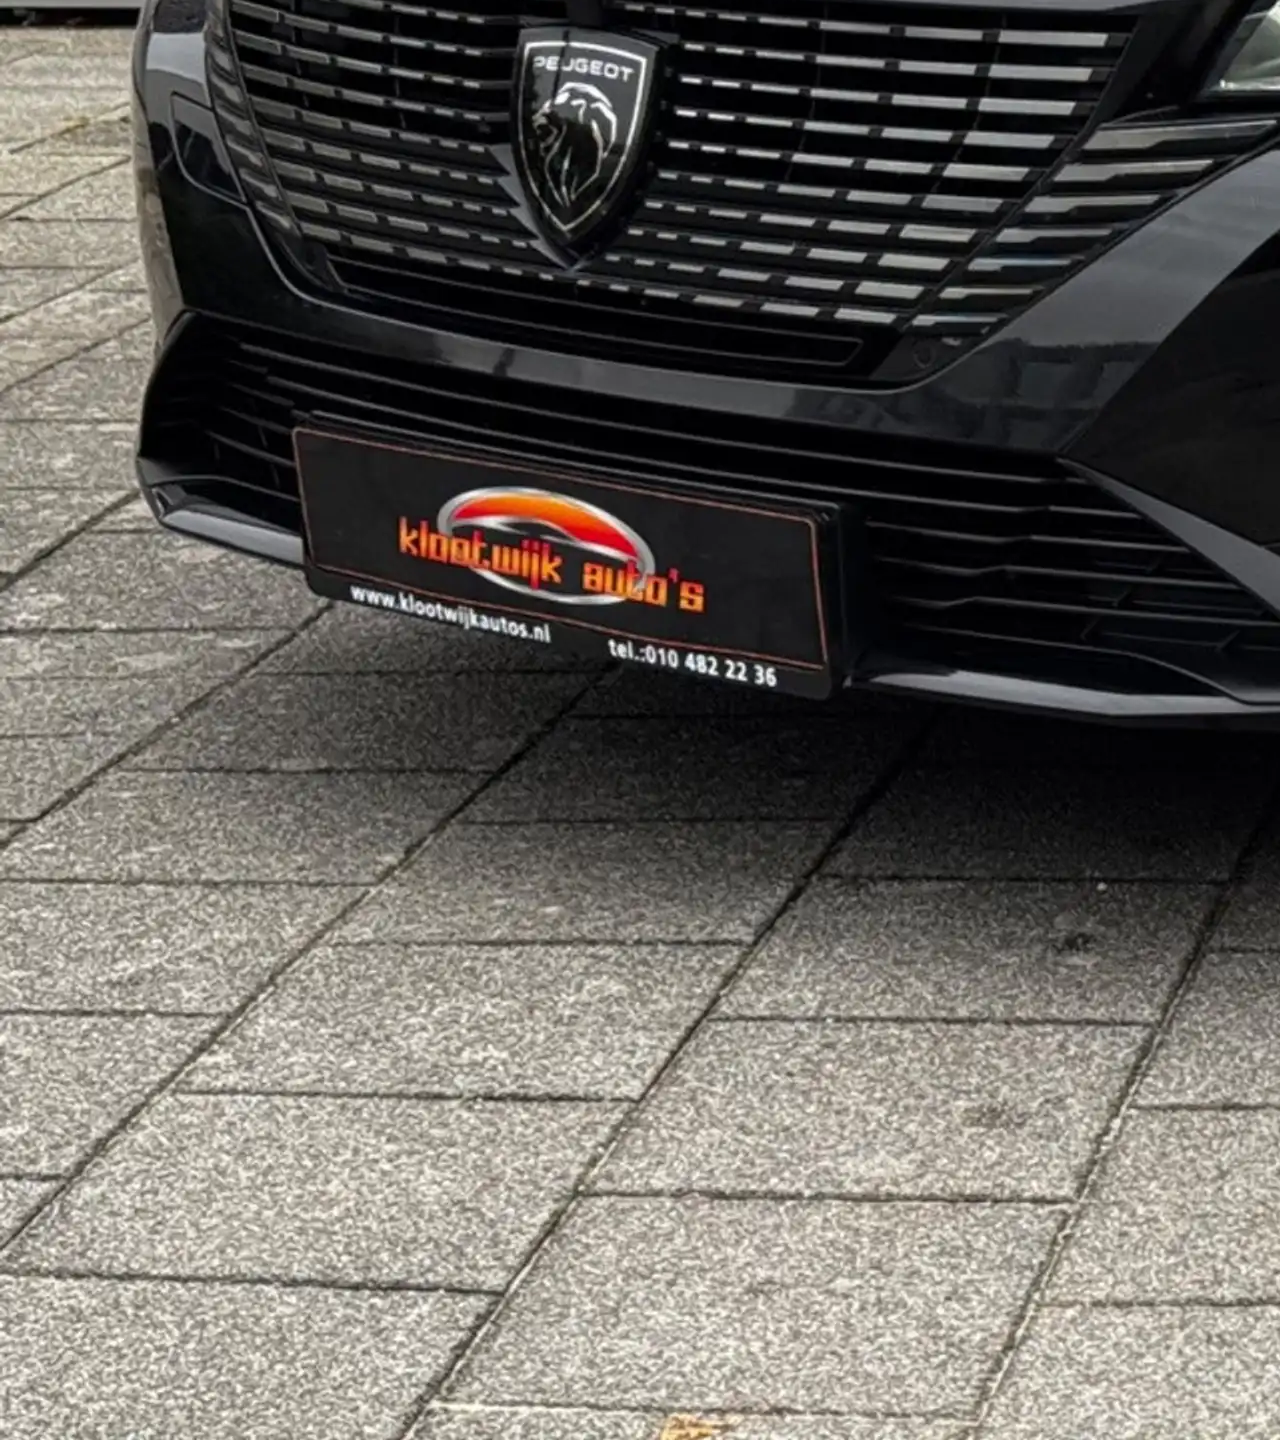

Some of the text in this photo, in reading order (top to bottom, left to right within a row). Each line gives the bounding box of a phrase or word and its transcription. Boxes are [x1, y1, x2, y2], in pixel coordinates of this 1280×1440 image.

[533, 55, 635, 82] PEUGEOT
[399, 516, 705, 612] klootwijk auto's
[350, 584, 551, 644] www.klootwijkautos.nl
[684, 653, 720, 676] 482
[725, 660, 748, 682] 22
[754, 664, 778, 687] 36
